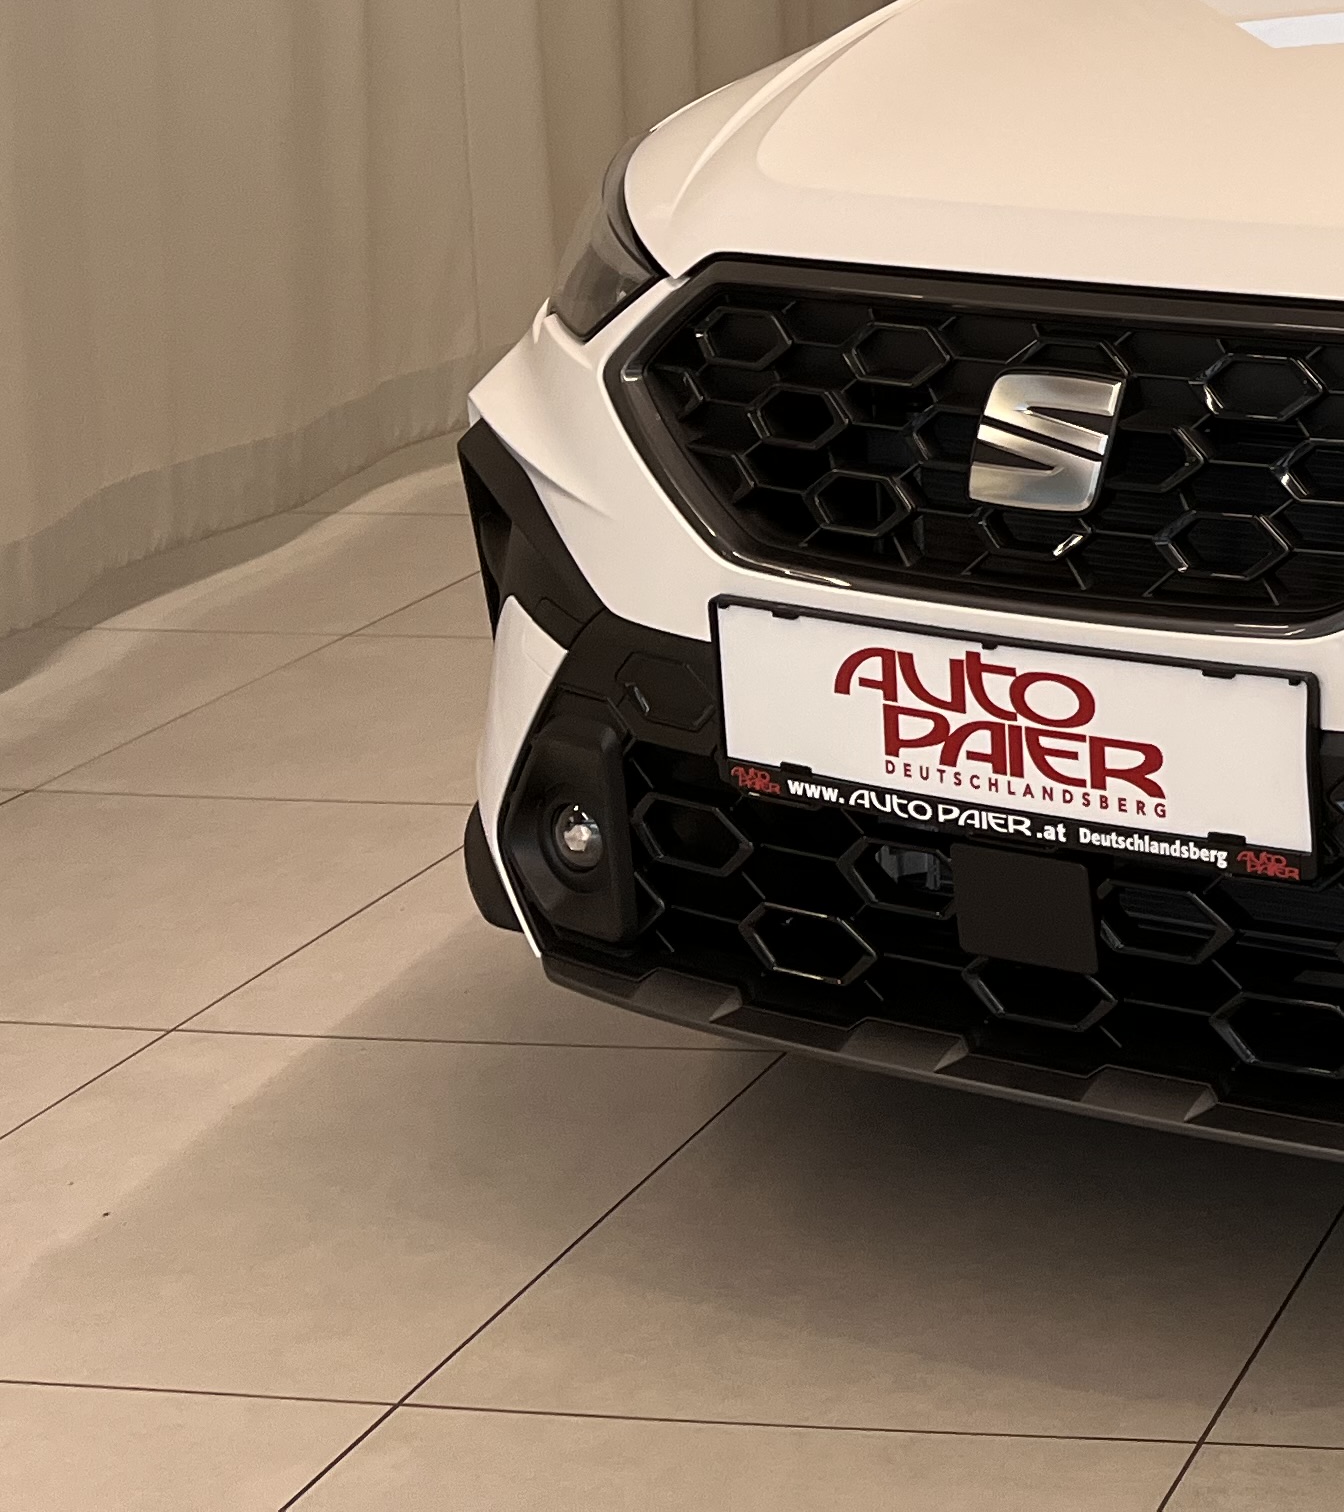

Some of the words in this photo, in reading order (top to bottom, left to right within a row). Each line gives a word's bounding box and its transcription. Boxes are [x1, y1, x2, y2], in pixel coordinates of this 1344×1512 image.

[882, 702, 1166, 800] PAIER
[884, 759, 1168, 819] DEUTSCHLANDSBERG
[1078, 827, 1228, 869] Deutschlandsberg
